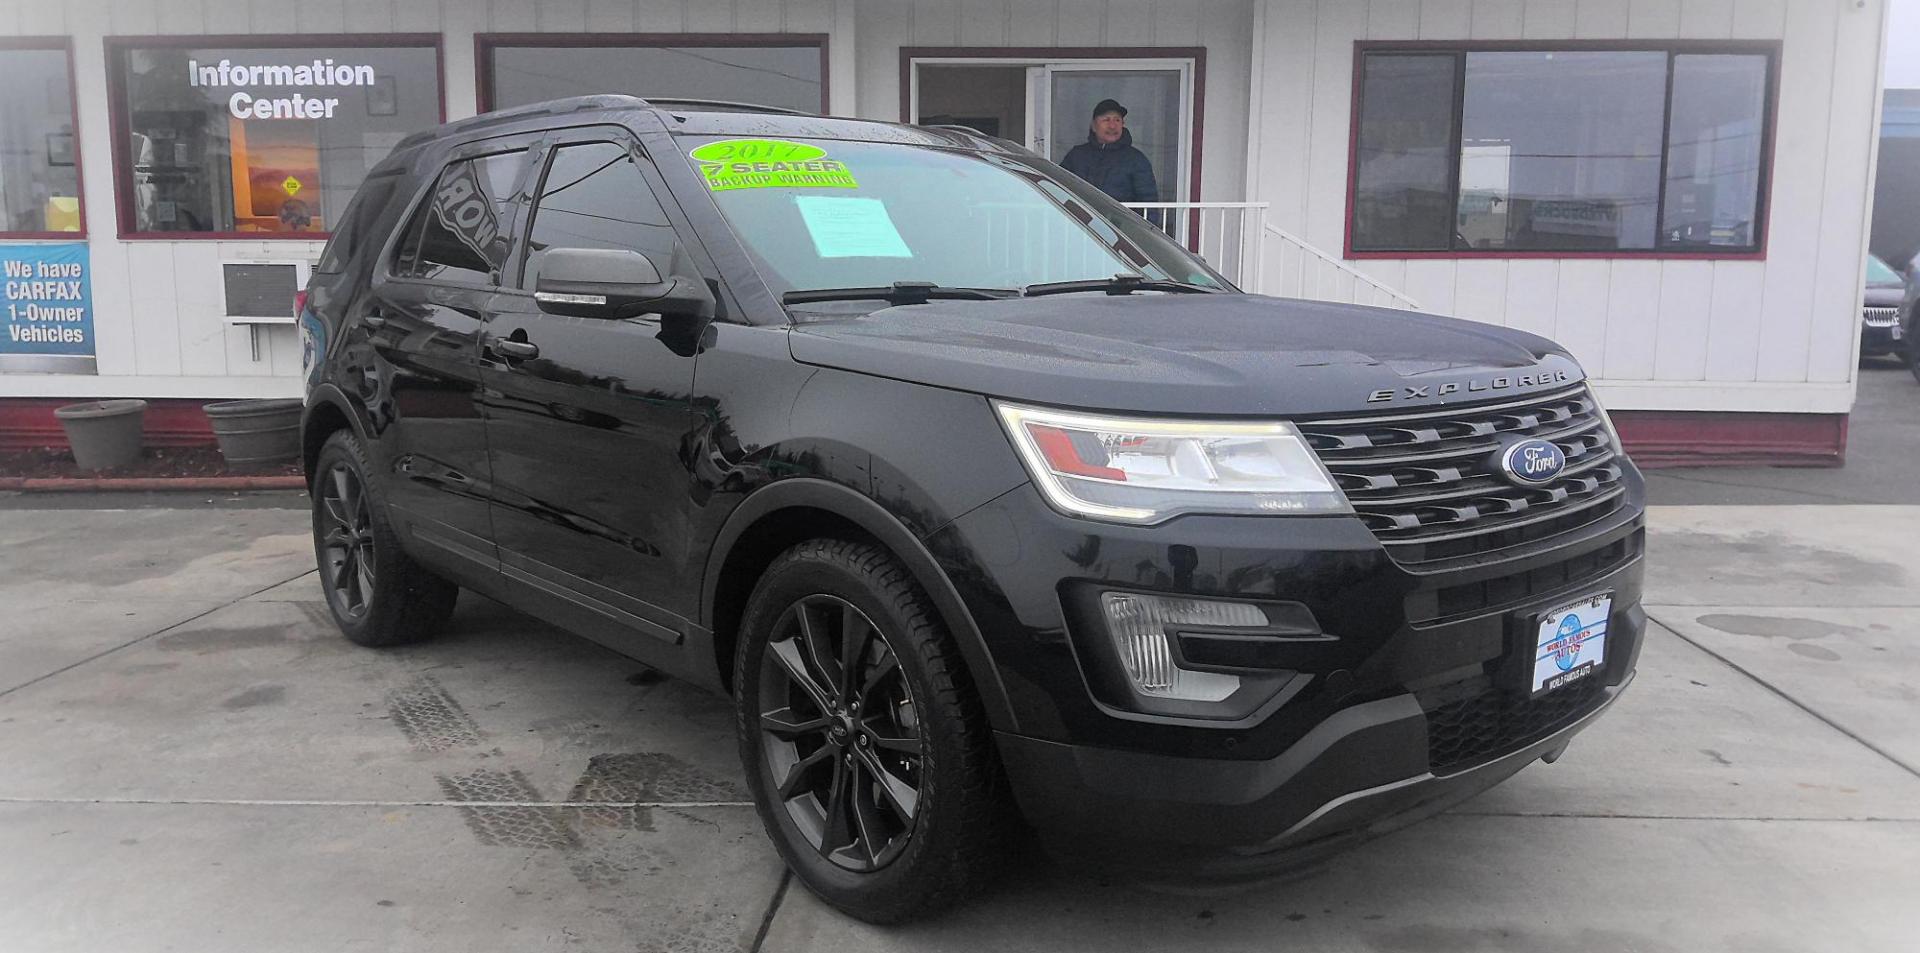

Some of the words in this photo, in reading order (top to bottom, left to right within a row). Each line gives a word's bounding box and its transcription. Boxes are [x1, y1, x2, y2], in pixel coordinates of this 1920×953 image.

[188, 59, 375, 87] Information
[229, 92, 338, 119] Center
[715, 145, 800, 160] 2017
[703, 164, 724, 177] 7
[731, 162, 842, 174] SEATER
[709, 176, 771, 188] BACKUP
[780, 174, 853, 185] WARNING
[4, 260, 32, 278] We
[37, 260, 82, 278] have
[6, 281, 82, 300] CARFAX
[8, 303, 84, 321] 1-Owner
[8, 324, 84, 342] Vehicles
[1367, 369, 1568, 402] EXPLORER
[1524, 447, 1557, 475] Ford
[1547, 639, 1567, 652] WORLD
[1568, 631, 1591, 644] FAMOUS
[1554, 643, 1581, 660] AUTOS
[1549, 677, 1564, 690] WORLD
[1564, 671, 1580, 684] FAMOUS
[1580, 666, 1591, 677] AUTO
